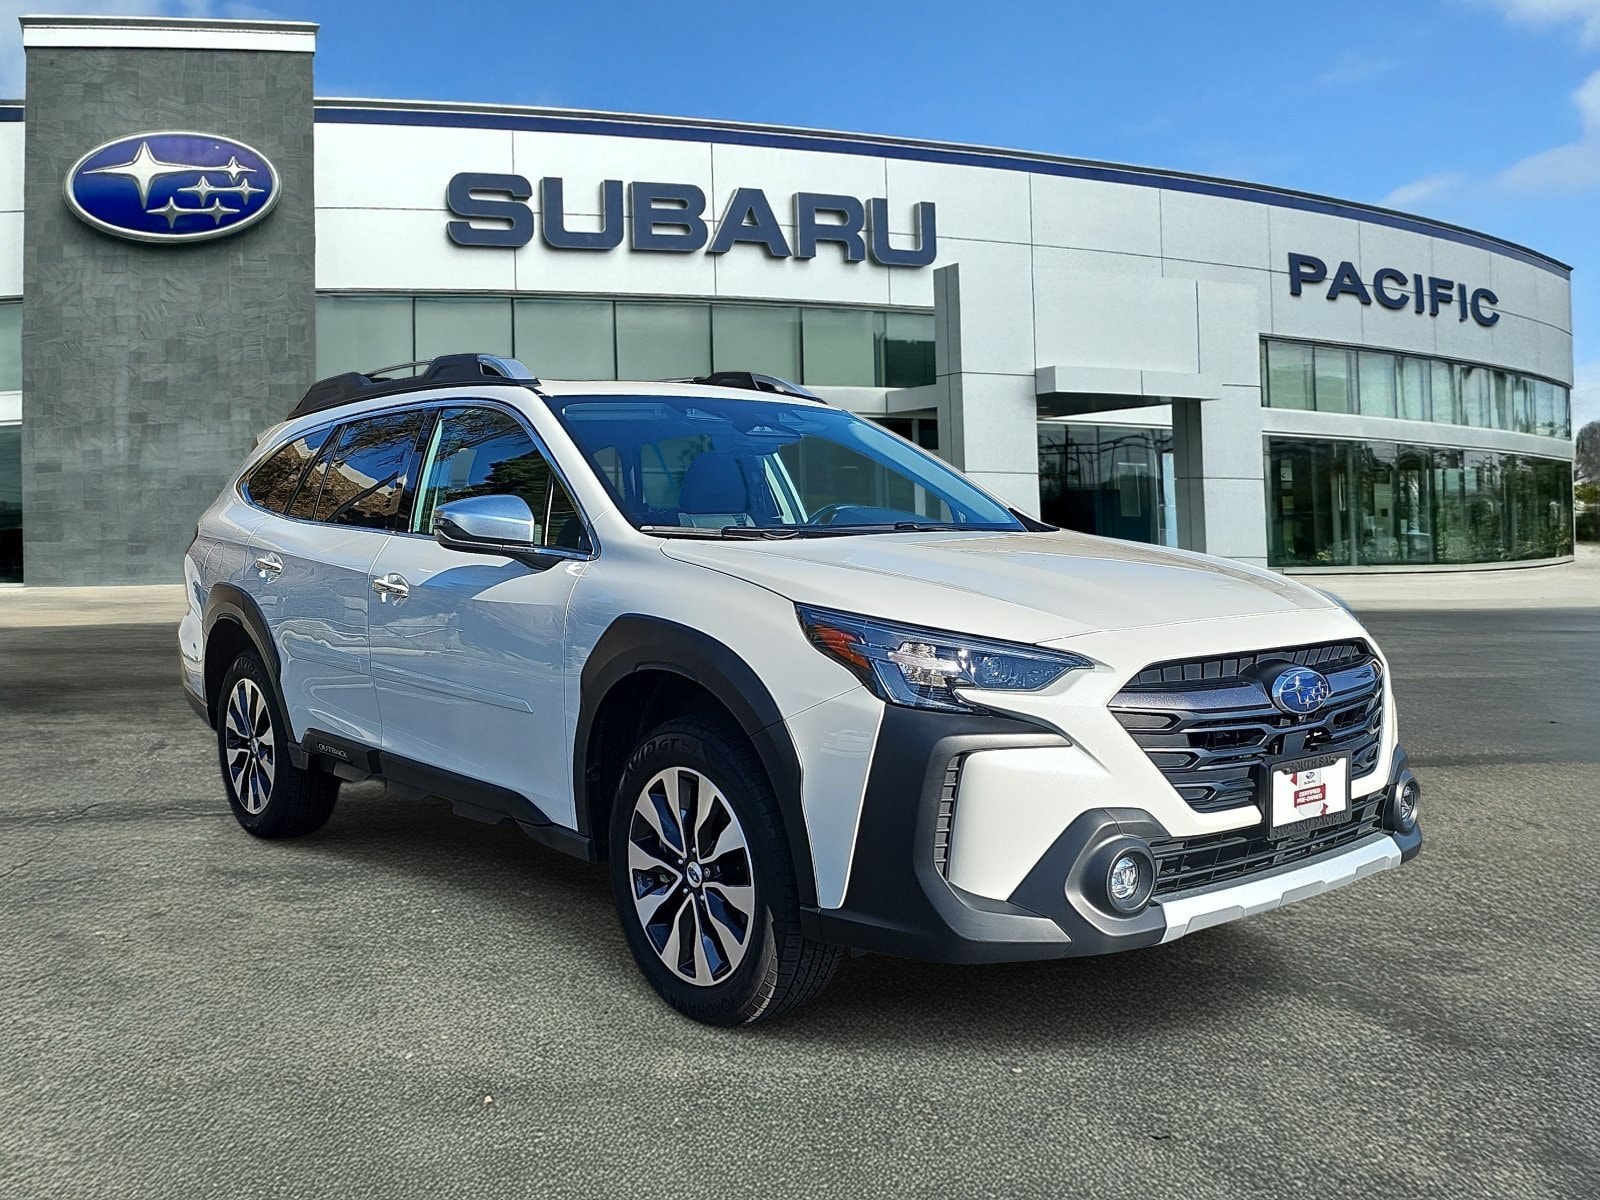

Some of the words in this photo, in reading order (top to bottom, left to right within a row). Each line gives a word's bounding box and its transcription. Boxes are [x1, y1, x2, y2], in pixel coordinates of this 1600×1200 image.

[446, 172, 937, 268] SUBARU
[1288, 252, 1500, 327] PACIFIC
[318, 743, 348, 759] OUTBACK
[1290, 758, 1318, 772] SOUTH
[1296, 793, 1323, 805] PRE-OWNED
[1299, 787, 1322, 798] CERTIFIED
